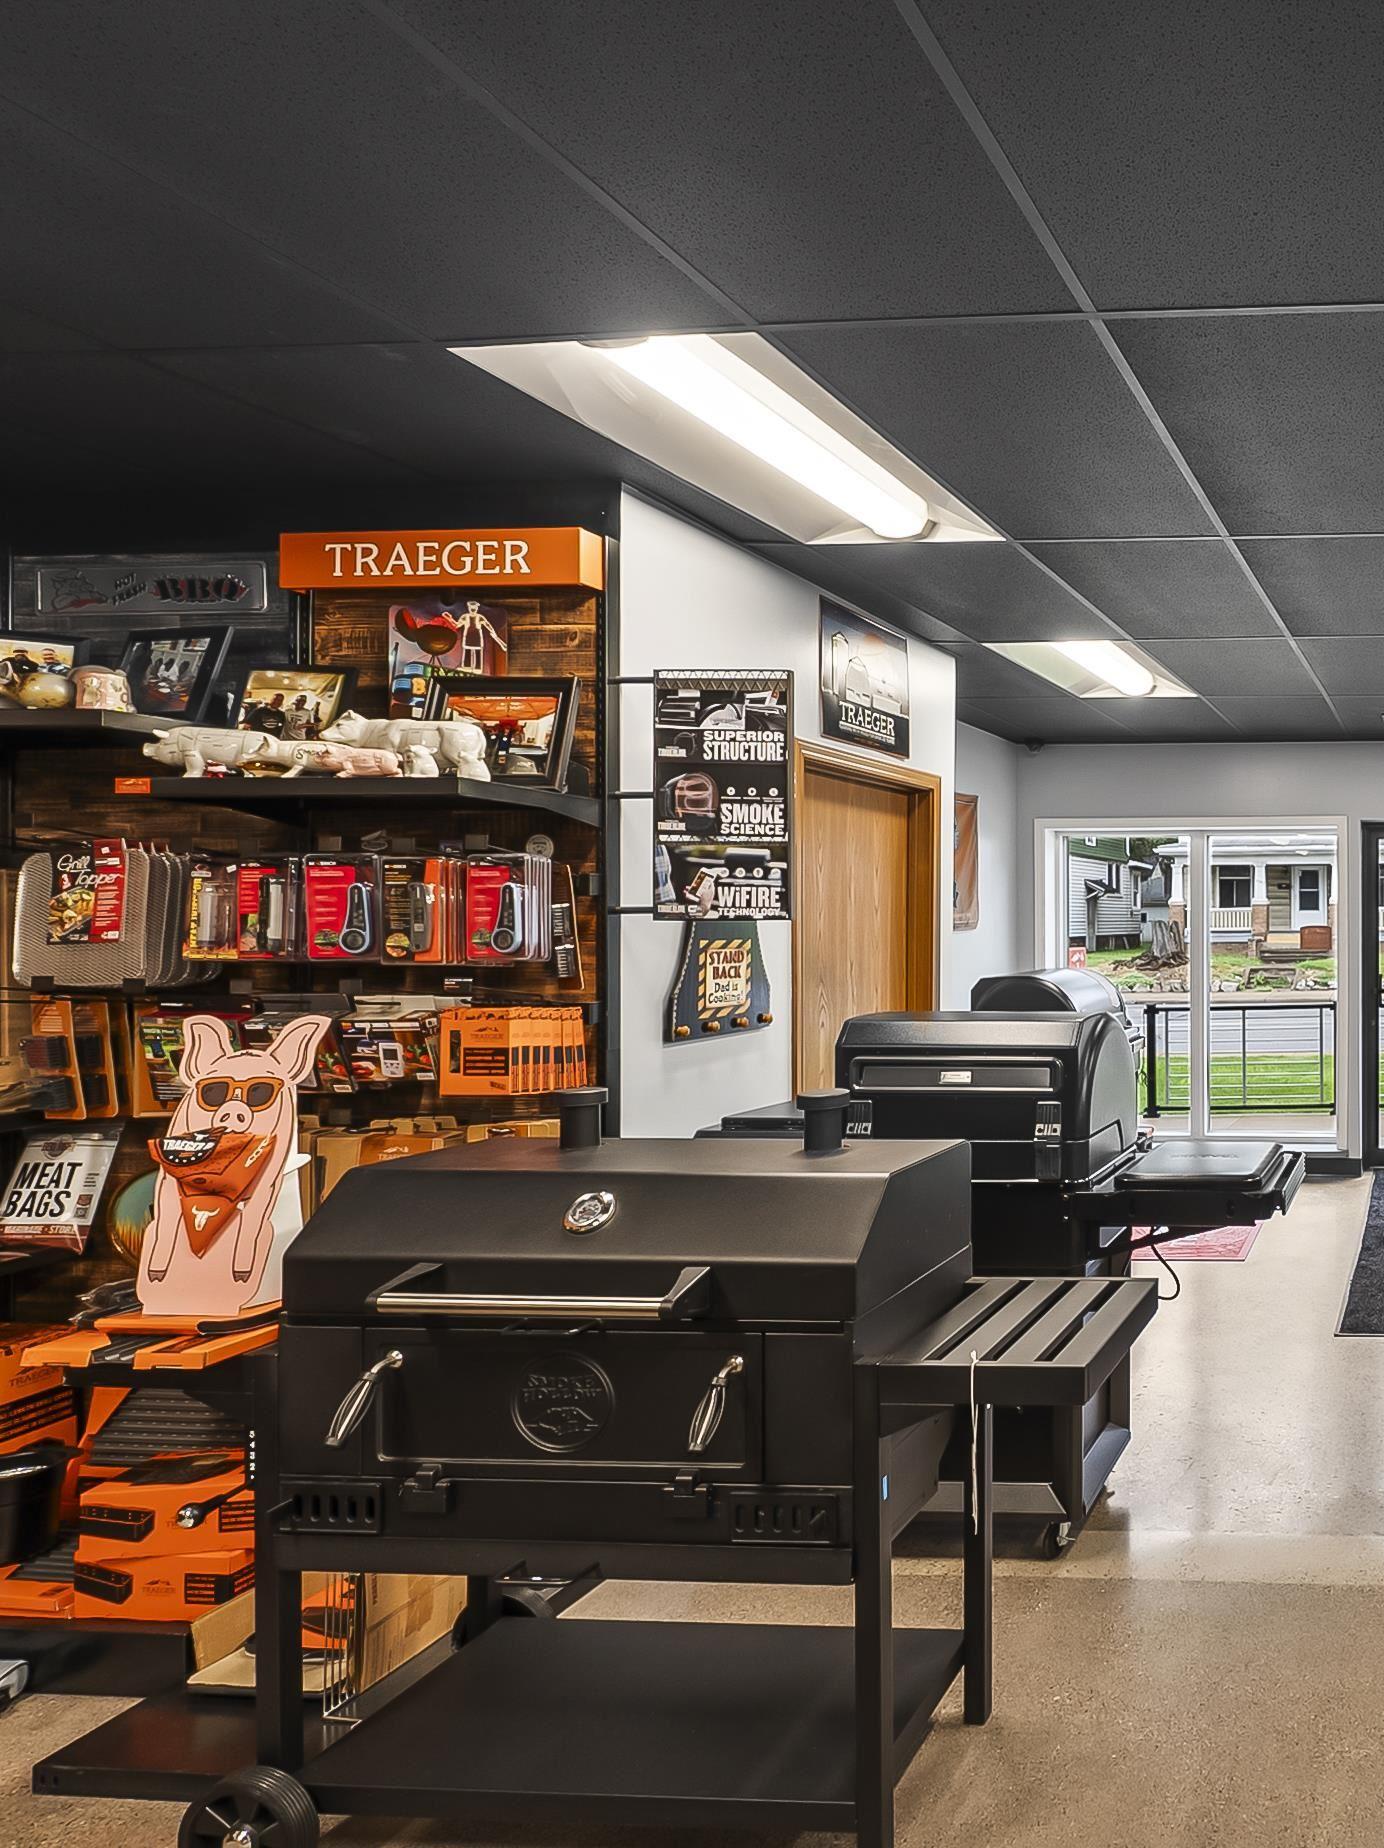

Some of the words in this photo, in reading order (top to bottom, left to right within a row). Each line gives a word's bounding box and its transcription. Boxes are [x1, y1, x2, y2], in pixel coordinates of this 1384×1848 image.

[325, 541, 530, 576] TRAEGER
[153, 575, 248, 602] BBQ
[838, 701, 895, 736] TRAEGER
[703, 731, 784, 741] SUPERIOR
[703, 742, 784, 761] STRUCTURE
[720, 803, 784, 823] SMOKE
[720, 824, 783, 835] SCIENCE
[57, 854, 91, 871] Grill
[75, 871, 124, 889] Topper
[718, 886, 781, 907] WiFIRE
[718, 908, 781, 916] TECHNOLOGY
[709, 950, 744, 965] STAND
[712, 965, 741, 980] BACK
[714, 980, 730, 993] Dad
[13, 1162, 83, 1189] MEAT
[2, 1190, 71, 1217] BAGS
